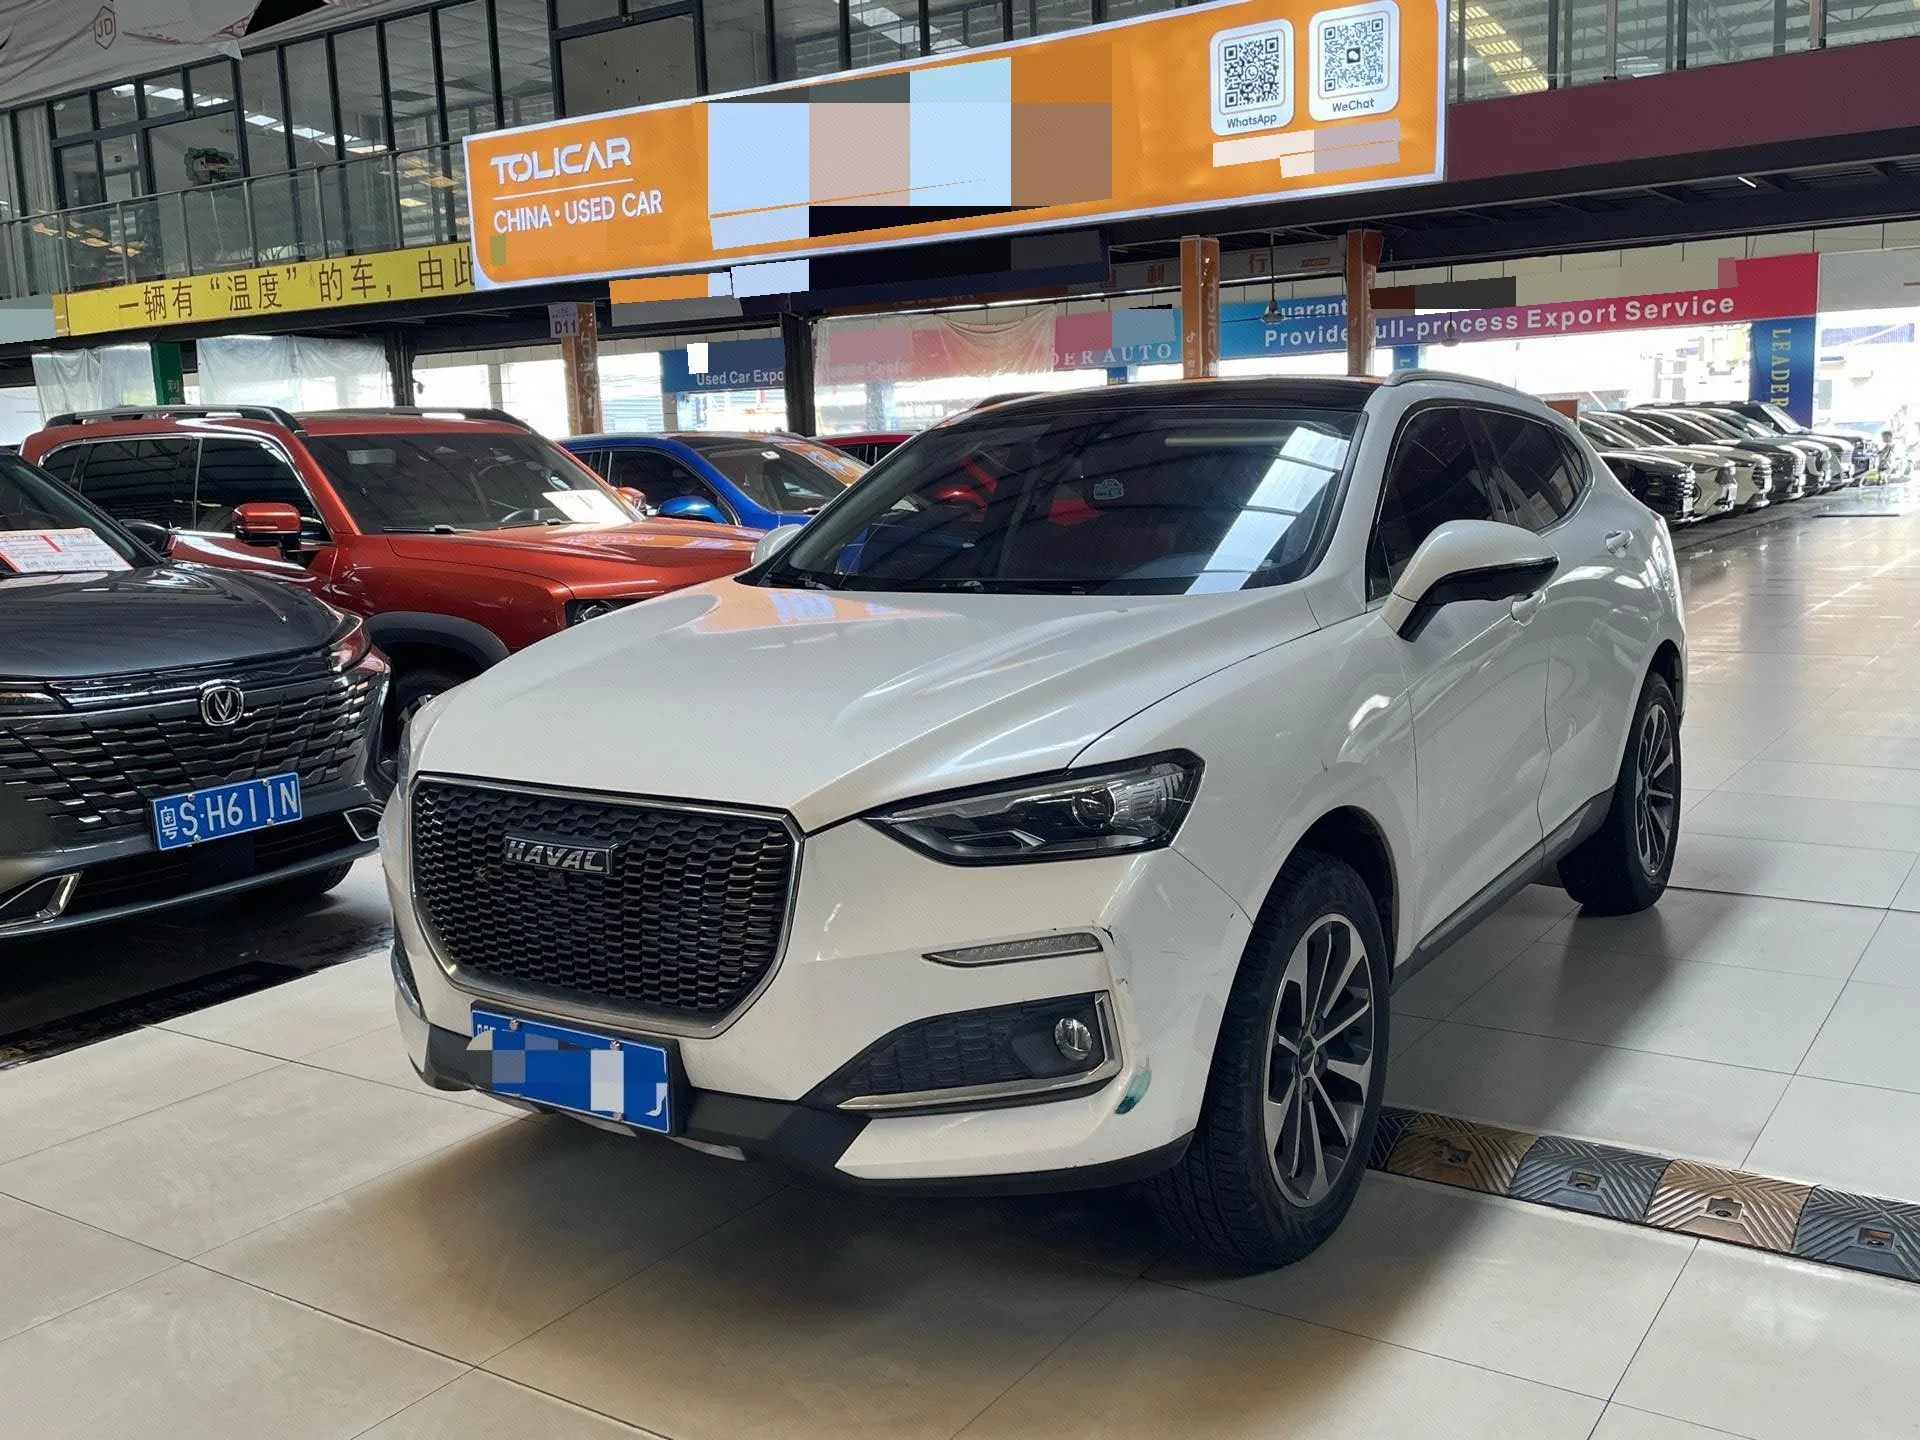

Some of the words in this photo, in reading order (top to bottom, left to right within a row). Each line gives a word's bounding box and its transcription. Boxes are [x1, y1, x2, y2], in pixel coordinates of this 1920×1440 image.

[97, 18, 113, 37] JD
[1332, 97, 1375, 113] WeChat
[1227, 113, 1277, 128] WhatsApp
[490, 137, 632, 185] TOLICAR
[564, 195, 616, 225] USED
[621, 189, 663, 218] CAR
[554, 319, 576, 335] D11
[1264, 324, 1347, 347] Provide
[1376, 315, 1518, 340] ull-process
[1527, 304, 1617, 330] Export
[1625, 295, 1735, 321] Service
[1103, 343, 1172, 363] AUTO
[1770, 327, 1792, 407] LEADER
[696, 371, 727, 386] Used
[729, 370, 751, 384] Car
[507, 841, 603, 871] HAVAL
